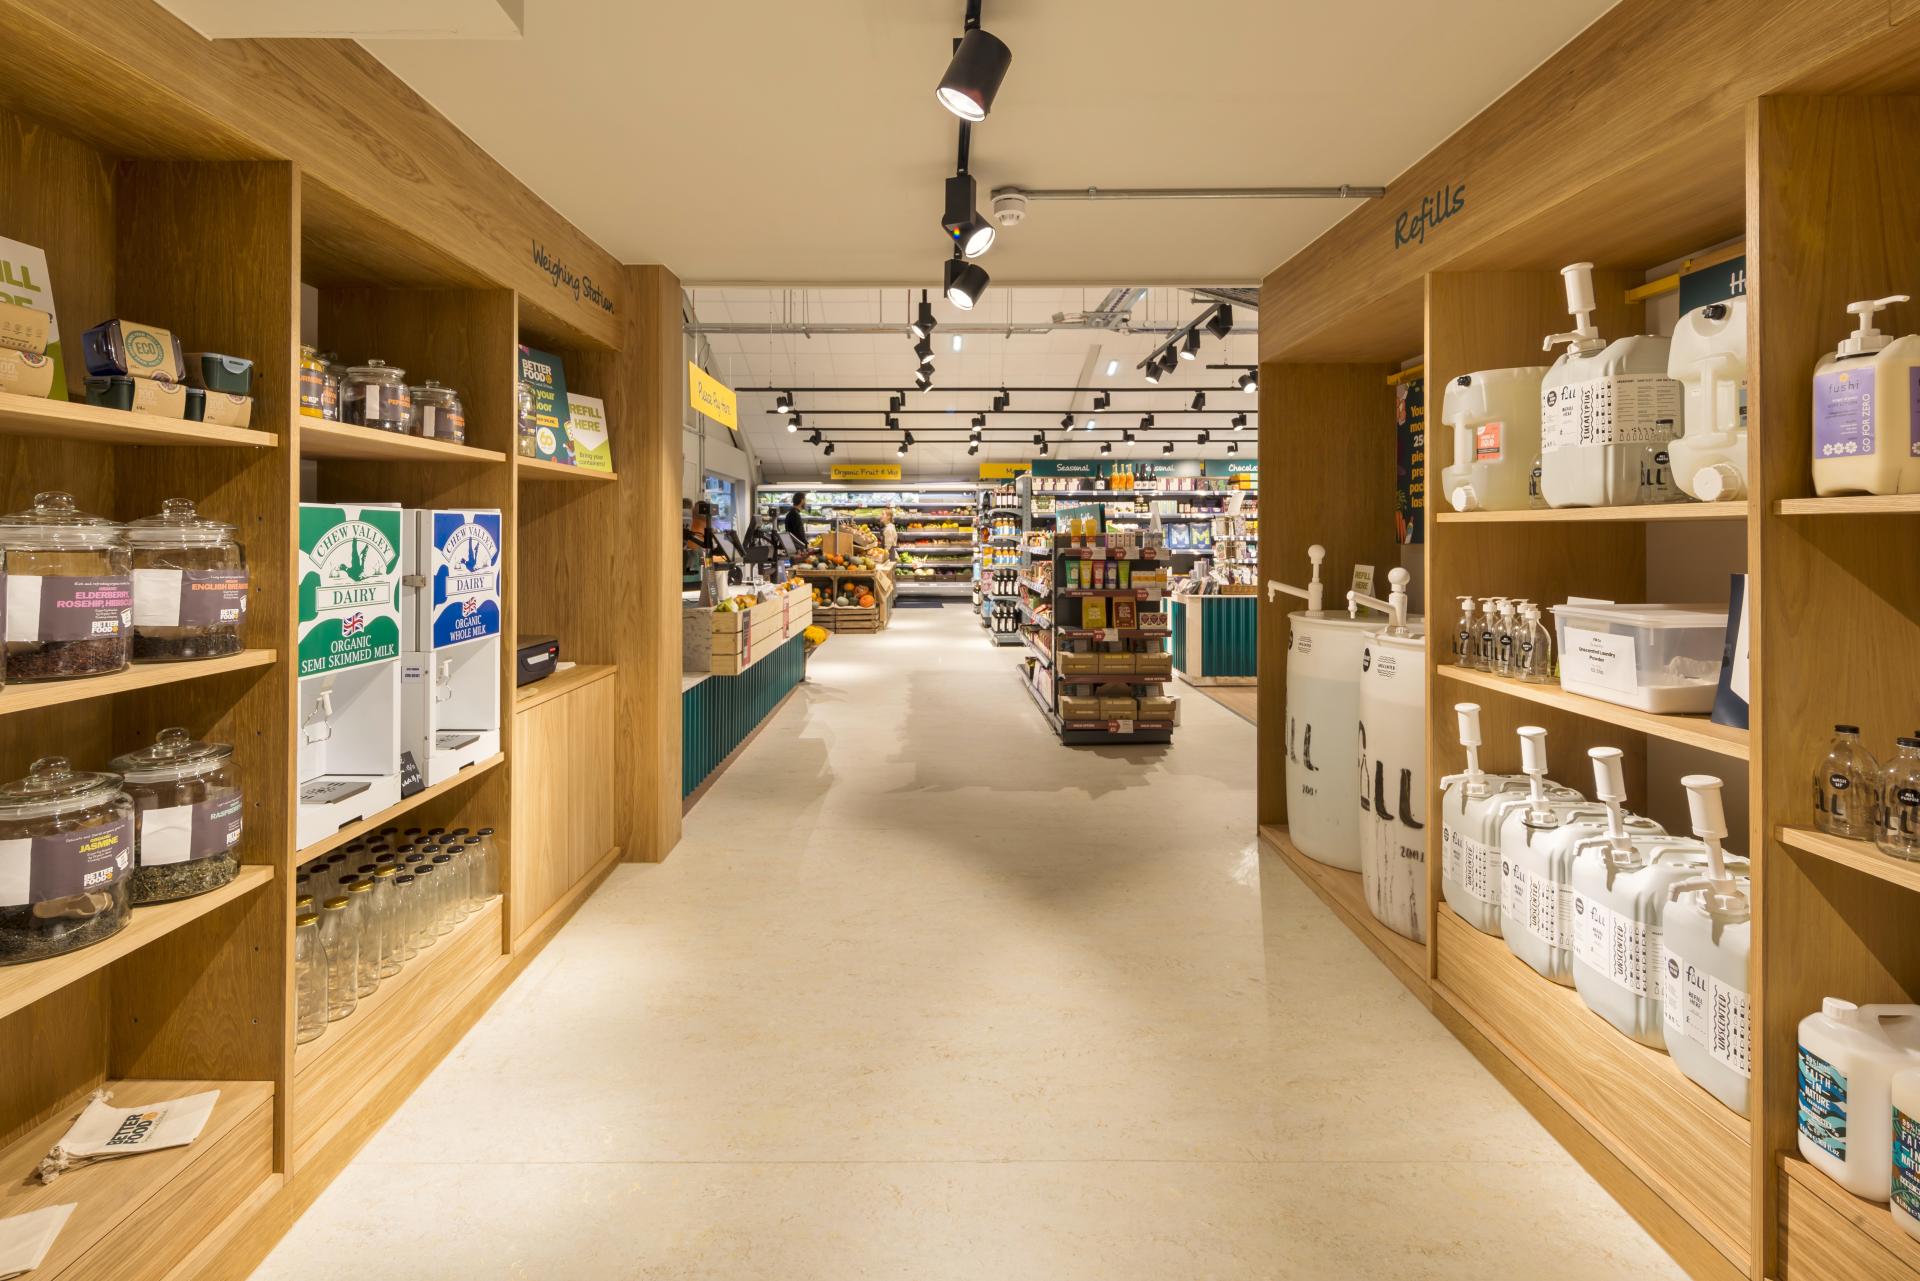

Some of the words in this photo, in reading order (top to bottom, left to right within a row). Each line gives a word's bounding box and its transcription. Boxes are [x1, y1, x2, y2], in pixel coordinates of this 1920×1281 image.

[1395, 185, 1465, 249] Refills
[532, 240, 580, 301] Weighing
[582, 276, 615, 315] Station
[134, 341, 157, 356] ECO
[521, 359, 552, 376] BETTER
[523, 369, 546, 382] FOOD
[1828, 380, 1860, 393] fushi
[569, 403, 602, 419] REFILL
[1862, 393, 1871, 417] ZERO
[575, 418, 601, 432] HERE
[1862, 420, 1871, 436] FOR
[1862, 438, 1871, 453] GO
[834, 468, 860, 478] Organic
[860, 468, 880, 477] Fruit
[1057, 464, 1091, 472] Seasonal
[317, 528, 349, 559] CHEW
[352, 524, 390, 556] VALLEY
[446, 528, 467, 554] CHEW
[468, 526, 494, 552] VALLEY
[456, 576, 485, 592] DAIRY
[1355, 571, 1371, 581] REFILL
[191, 583, 227, 591] ENGLISH
[1355, 581, 1369, 590] HERE
[333, 587, 377, 606] DAIRY
[91, 620, 119, 628] BETTER
[455, 614, 482, 630] ORGANIC
[450, 628, 472, 642] WHOLE
[472, 624, 486, 637] MILK
[330, 635, 372, 654] ORGANIC
[301, 658, 326, 674] SEMI
[328, 647, 372, 668] SKIMMED
[374, 643, 395, 658] MILK
[79, 835, 120, 854] JASMINE
[83, 875, 107, 888] FOOD
[84, 866, 114, 881] BETTER
[1616, 925, 1624, 975] UNSCENTED
[1717, 994, 1727, 1051] UNSCENTED
[1805, 1065, 1831, 1090] FAITH
[1811, 1081, 1822, 1094] IN
[1804, 1084, 1831, 1110] NATURE
[105, 1113, 144, 1146] BETTER
[122, 1120, 153, 1144] FOOD
